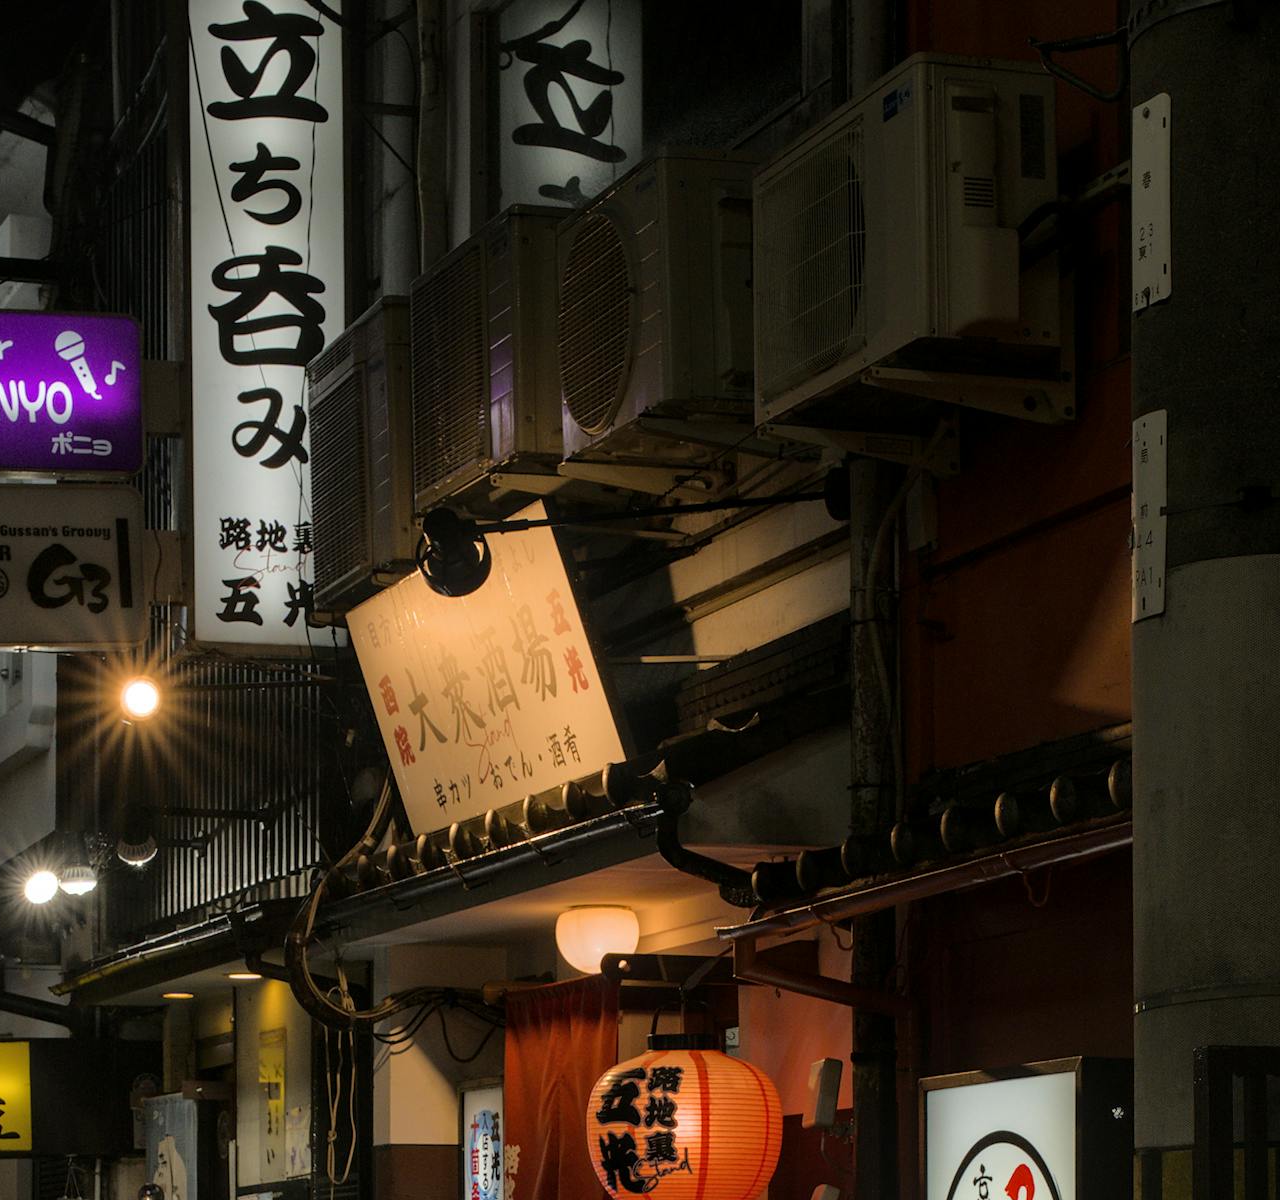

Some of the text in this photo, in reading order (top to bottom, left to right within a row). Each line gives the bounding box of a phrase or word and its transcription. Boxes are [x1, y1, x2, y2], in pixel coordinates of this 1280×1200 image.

[207, 0, 328, 468] 立ち呑み
[0, 525, 58, 538] Gussan's
[62, 526, 111, 541] Groovy
[27, 543, 112, 614] G3
[219, 517, 314, 554] 路地裏
[403, 604, 558, 753] 大衆酒場
[547, 588, 589, 694] 五光
[378, 674, 417, 767] 西院
[596, 1067, 647, 1194] 五光
[644, 1066, 684, 1163] 路地裏
[632, 1147, 693, 1193] Stand
